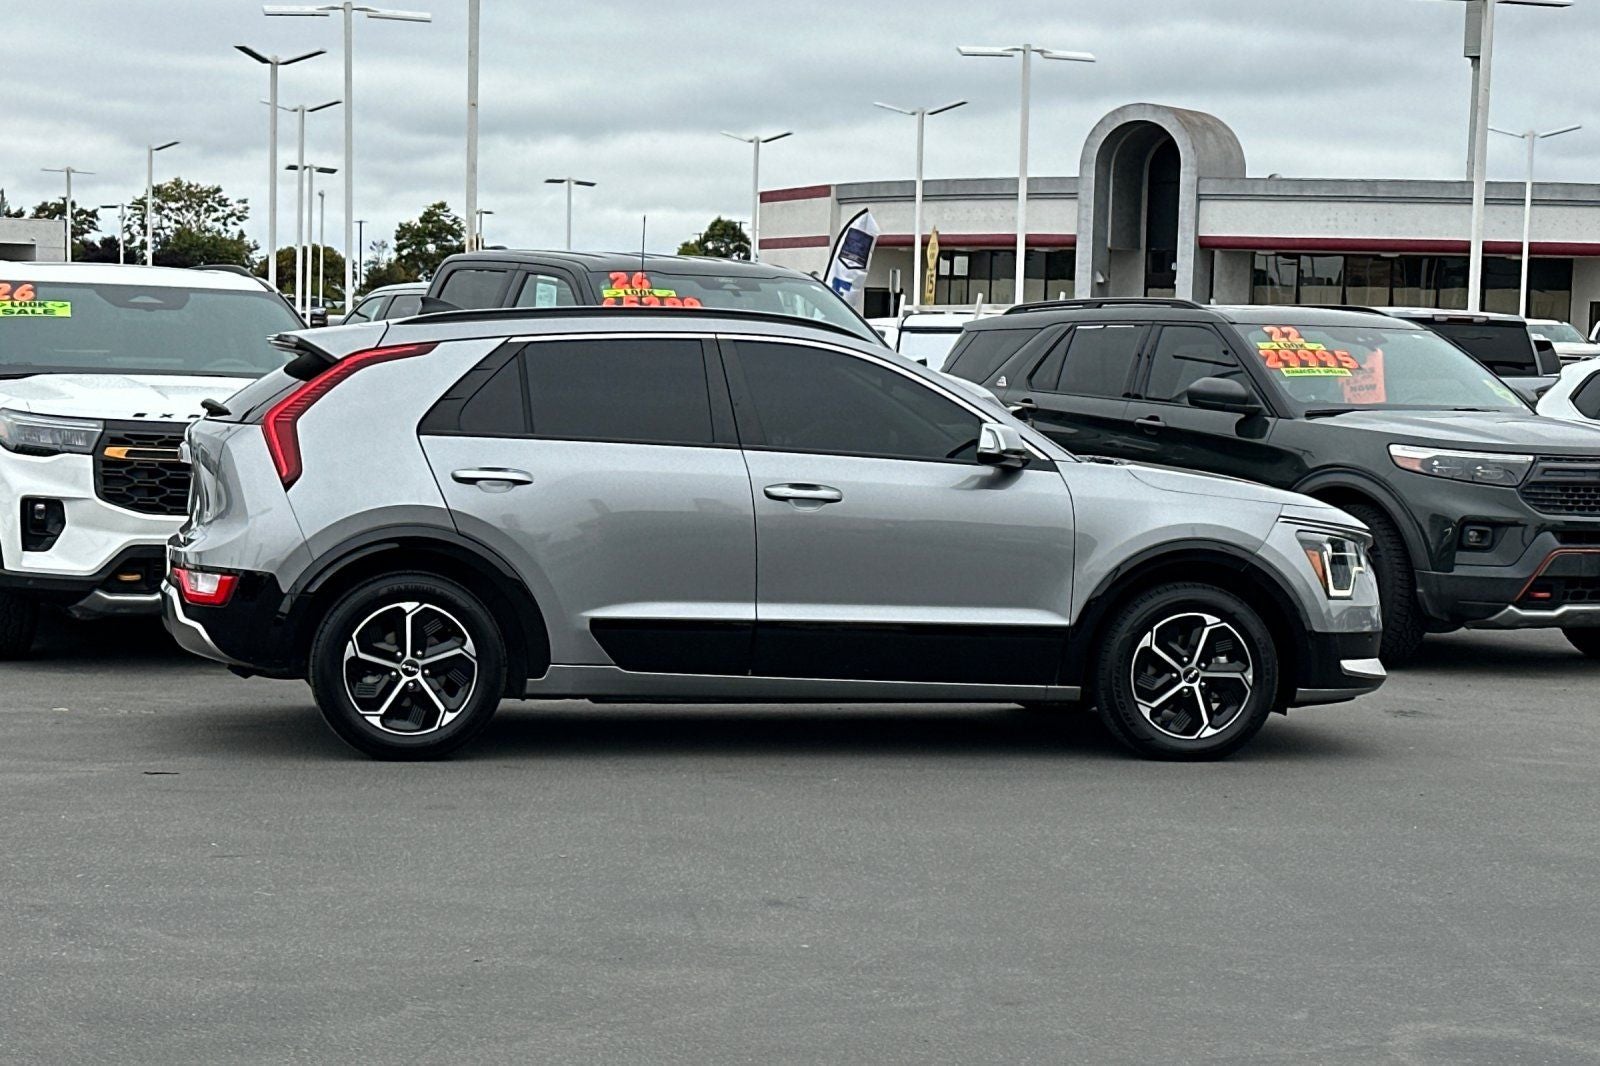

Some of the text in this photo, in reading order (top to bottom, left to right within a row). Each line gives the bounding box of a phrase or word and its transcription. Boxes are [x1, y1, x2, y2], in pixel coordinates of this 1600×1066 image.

[609, 271, 651, 289] 26
[0, 283, 36, 301] 26
[623, 289, 656, 297] LOOK
[1263, 326, 1305, 342] 22
[1258, 349, 1360, 369] 29995
